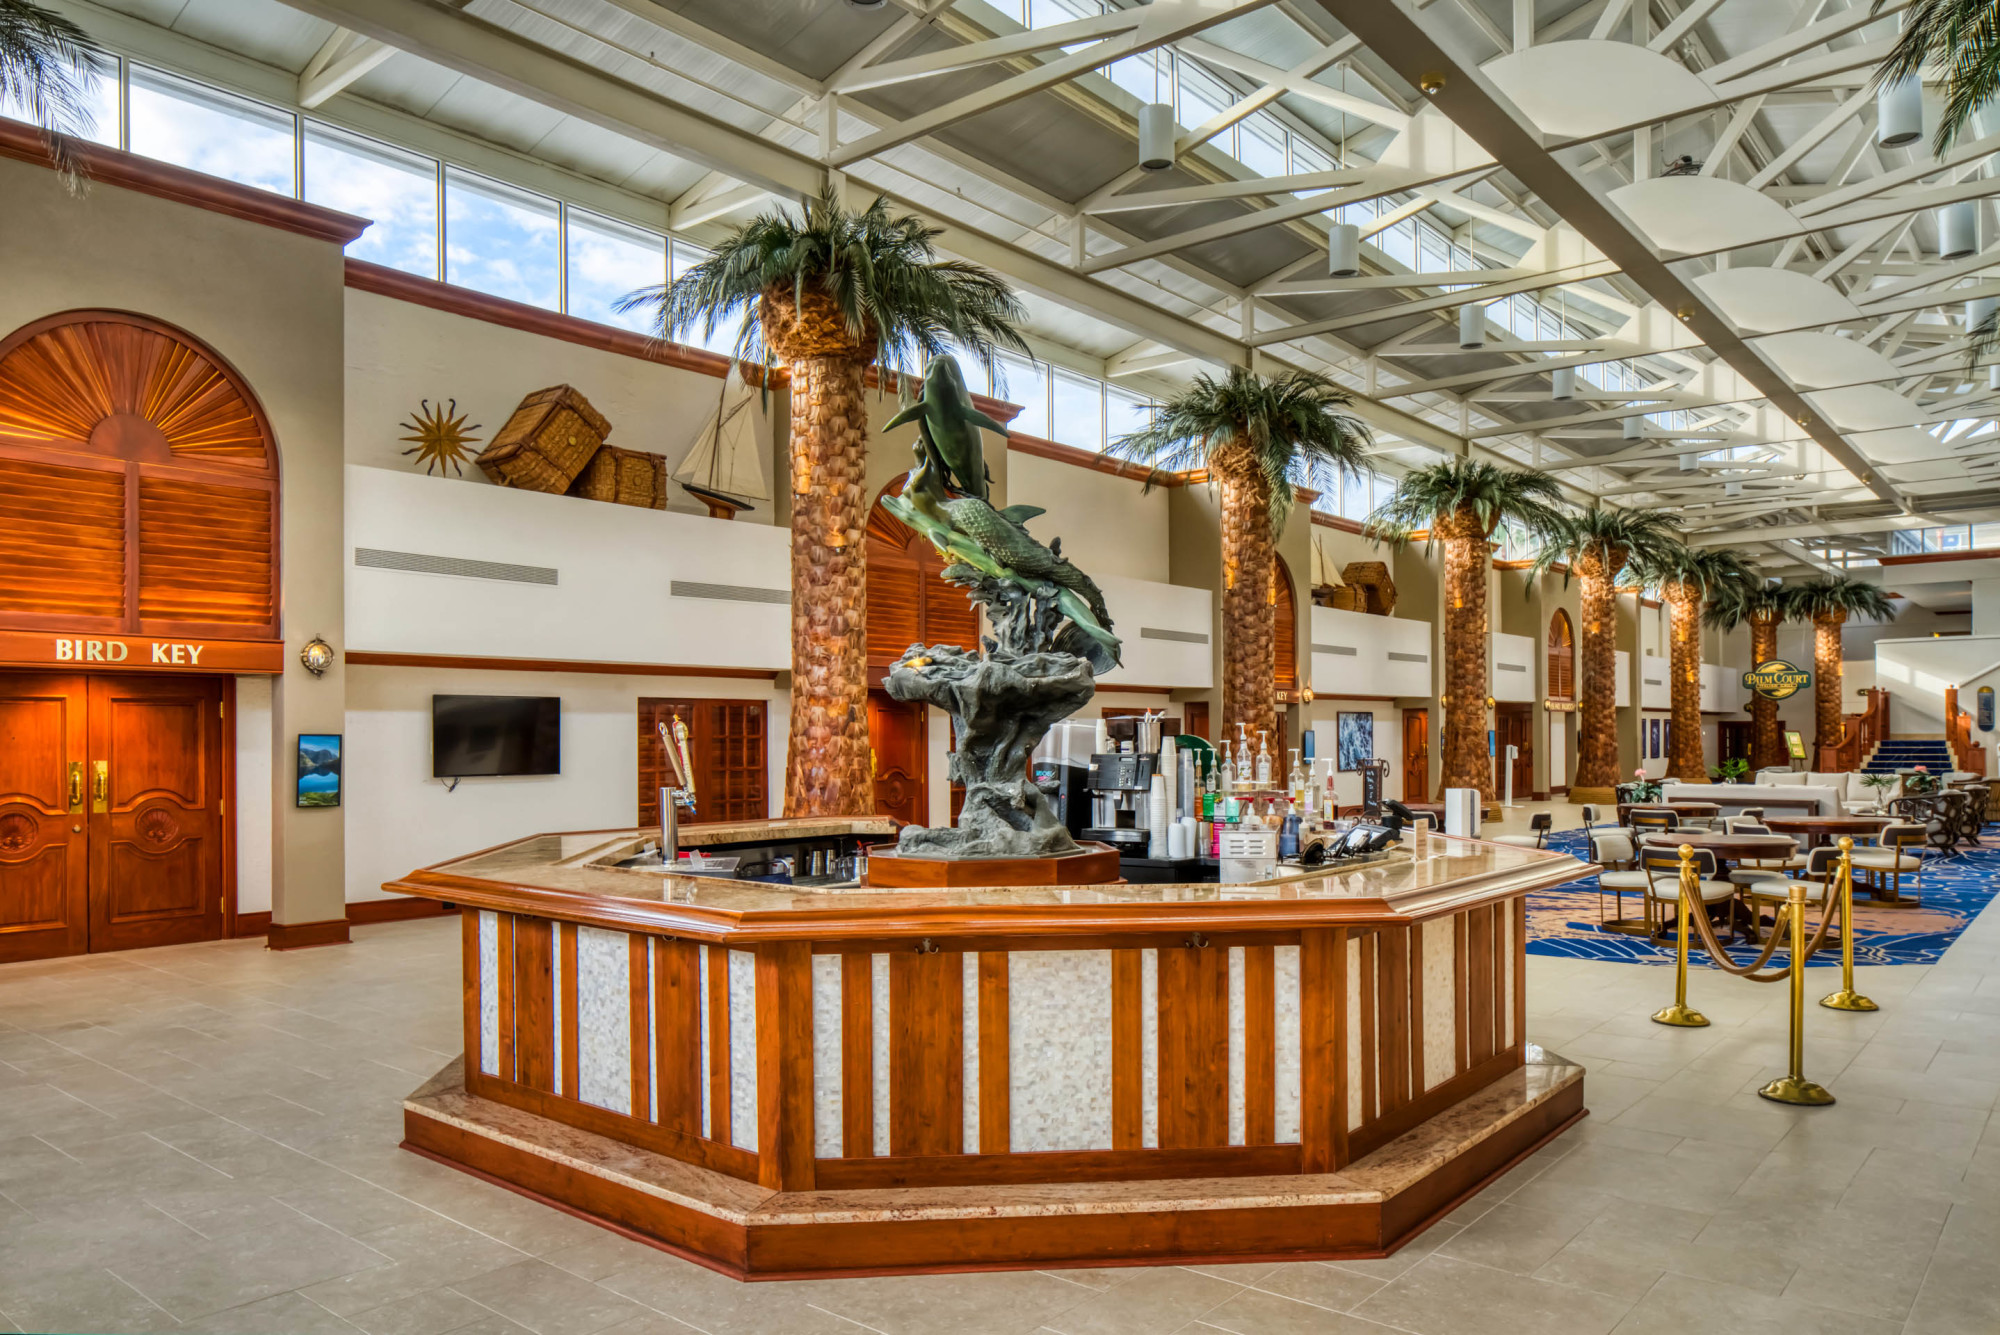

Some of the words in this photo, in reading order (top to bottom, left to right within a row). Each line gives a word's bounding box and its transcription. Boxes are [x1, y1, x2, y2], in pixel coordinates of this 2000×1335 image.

[56, 638, 128, 662] BIRD
[152, 642, 204, 665] KEY
[1745, 672, 1773, 685] PALM
[1773, 672, 1808, 684] COURT
[1276, 690, 1288, 701] KEY
